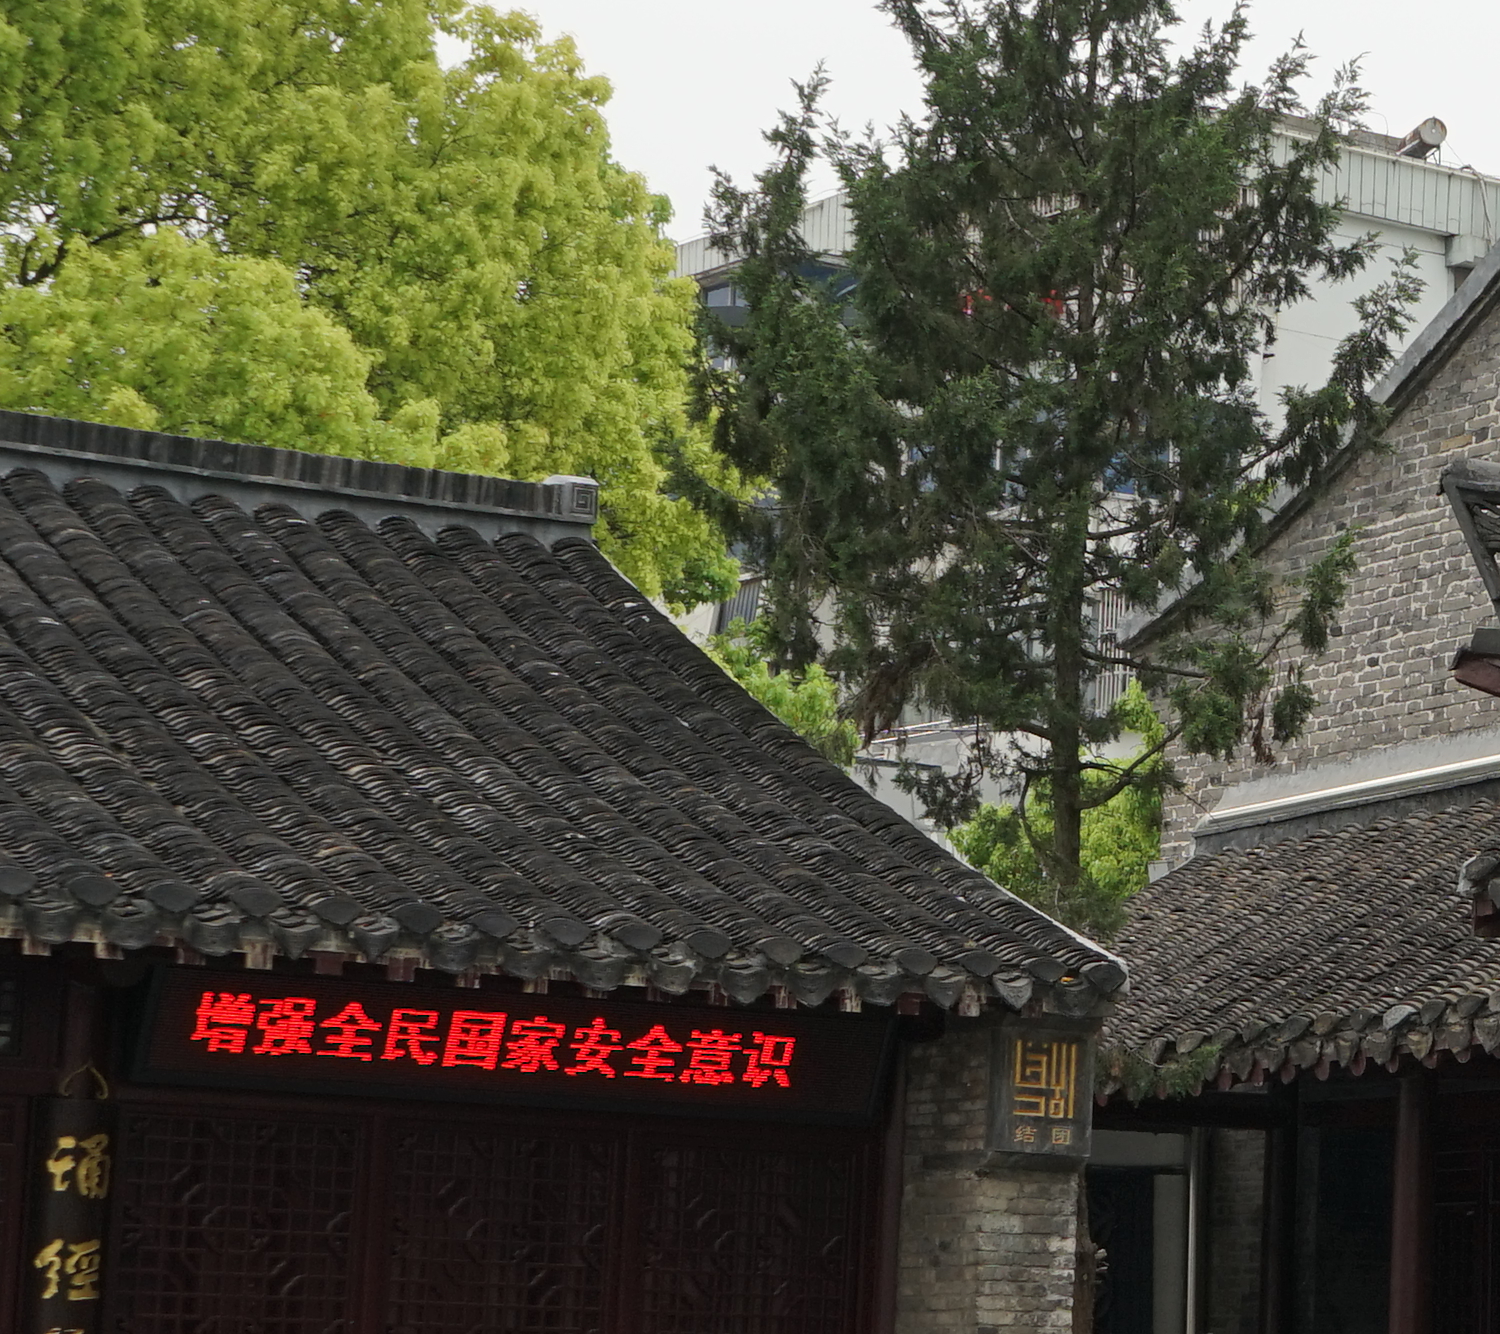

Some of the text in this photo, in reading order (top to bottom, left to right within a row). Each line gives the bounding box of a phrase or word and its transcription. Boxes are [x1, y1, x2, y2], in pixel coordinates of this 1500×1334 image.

[190, 990, 799, 1090] 增强全民国家安全意识
[1013, 1126, 1072, 1145] 团结
